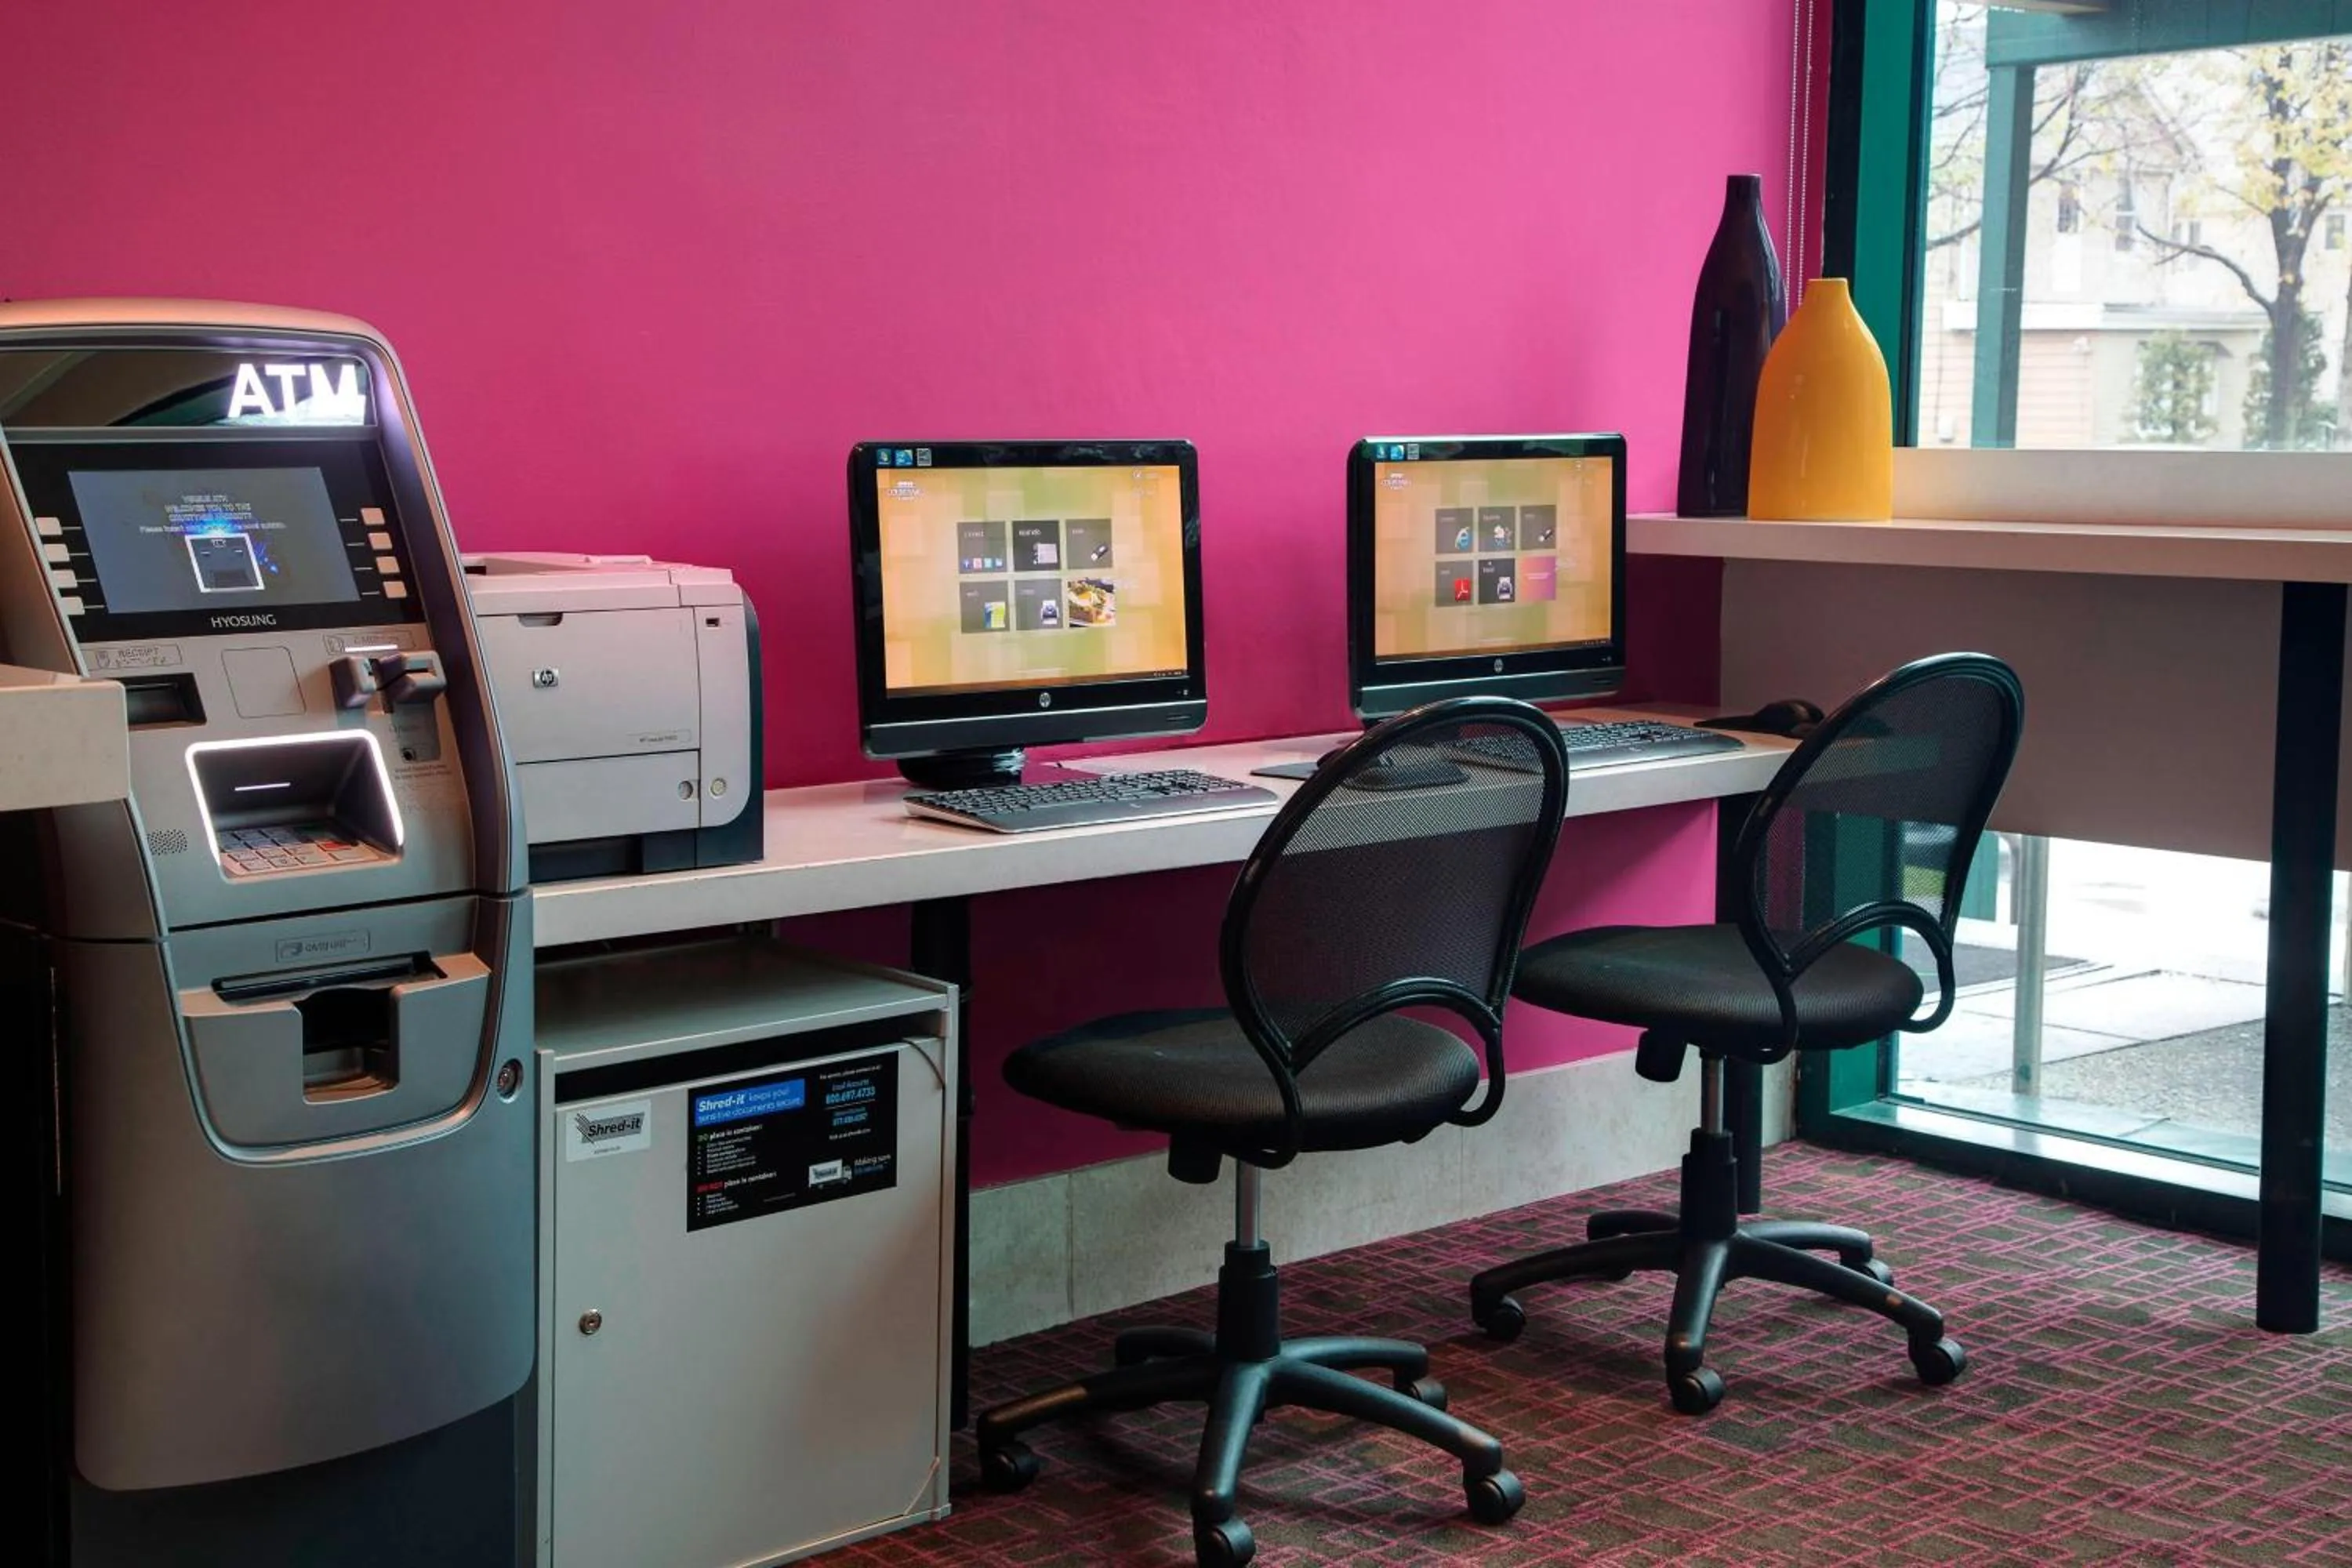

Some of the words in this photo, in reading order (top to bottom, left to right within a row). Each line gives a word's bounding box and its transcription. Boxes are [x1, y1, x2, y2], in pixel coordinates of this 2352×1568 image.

[227, 363, 366, 419] ATM
[211, 614, 277, 627] HYOSUNG
[699, 1093, 746, 1112] Shred-it
[587, 1117, 641, 1138] Shred-it
